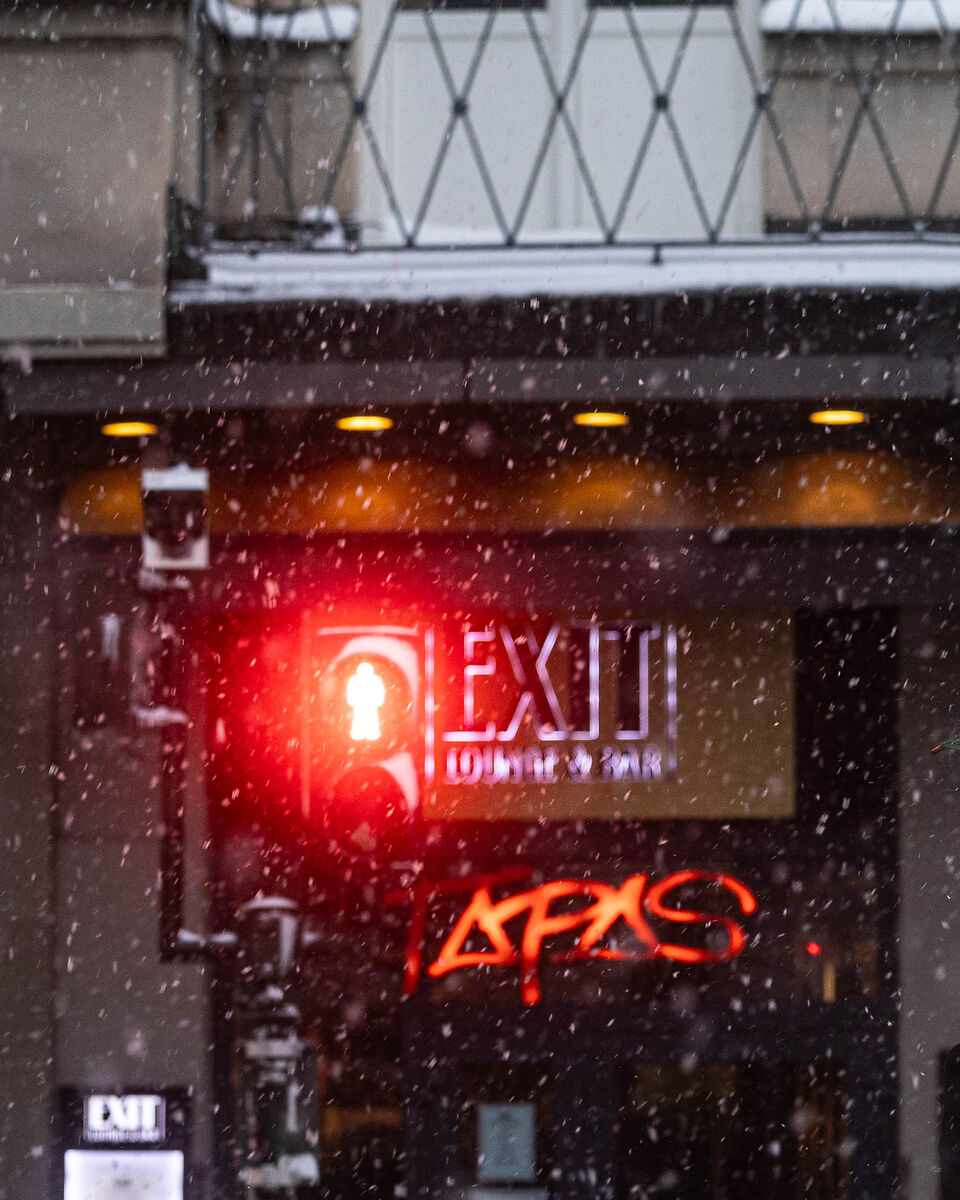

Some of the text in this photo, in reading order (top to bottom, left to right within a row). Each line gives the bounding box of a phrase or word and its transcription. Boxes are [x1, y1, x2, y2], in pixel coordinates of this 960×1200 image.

[441, 621, 661, 742] EXIT
[446, 744, 559, 785] LOUNGE
[600, 744, 663, 785] BAR
[87, 1094, 161, 1132] EXIT
